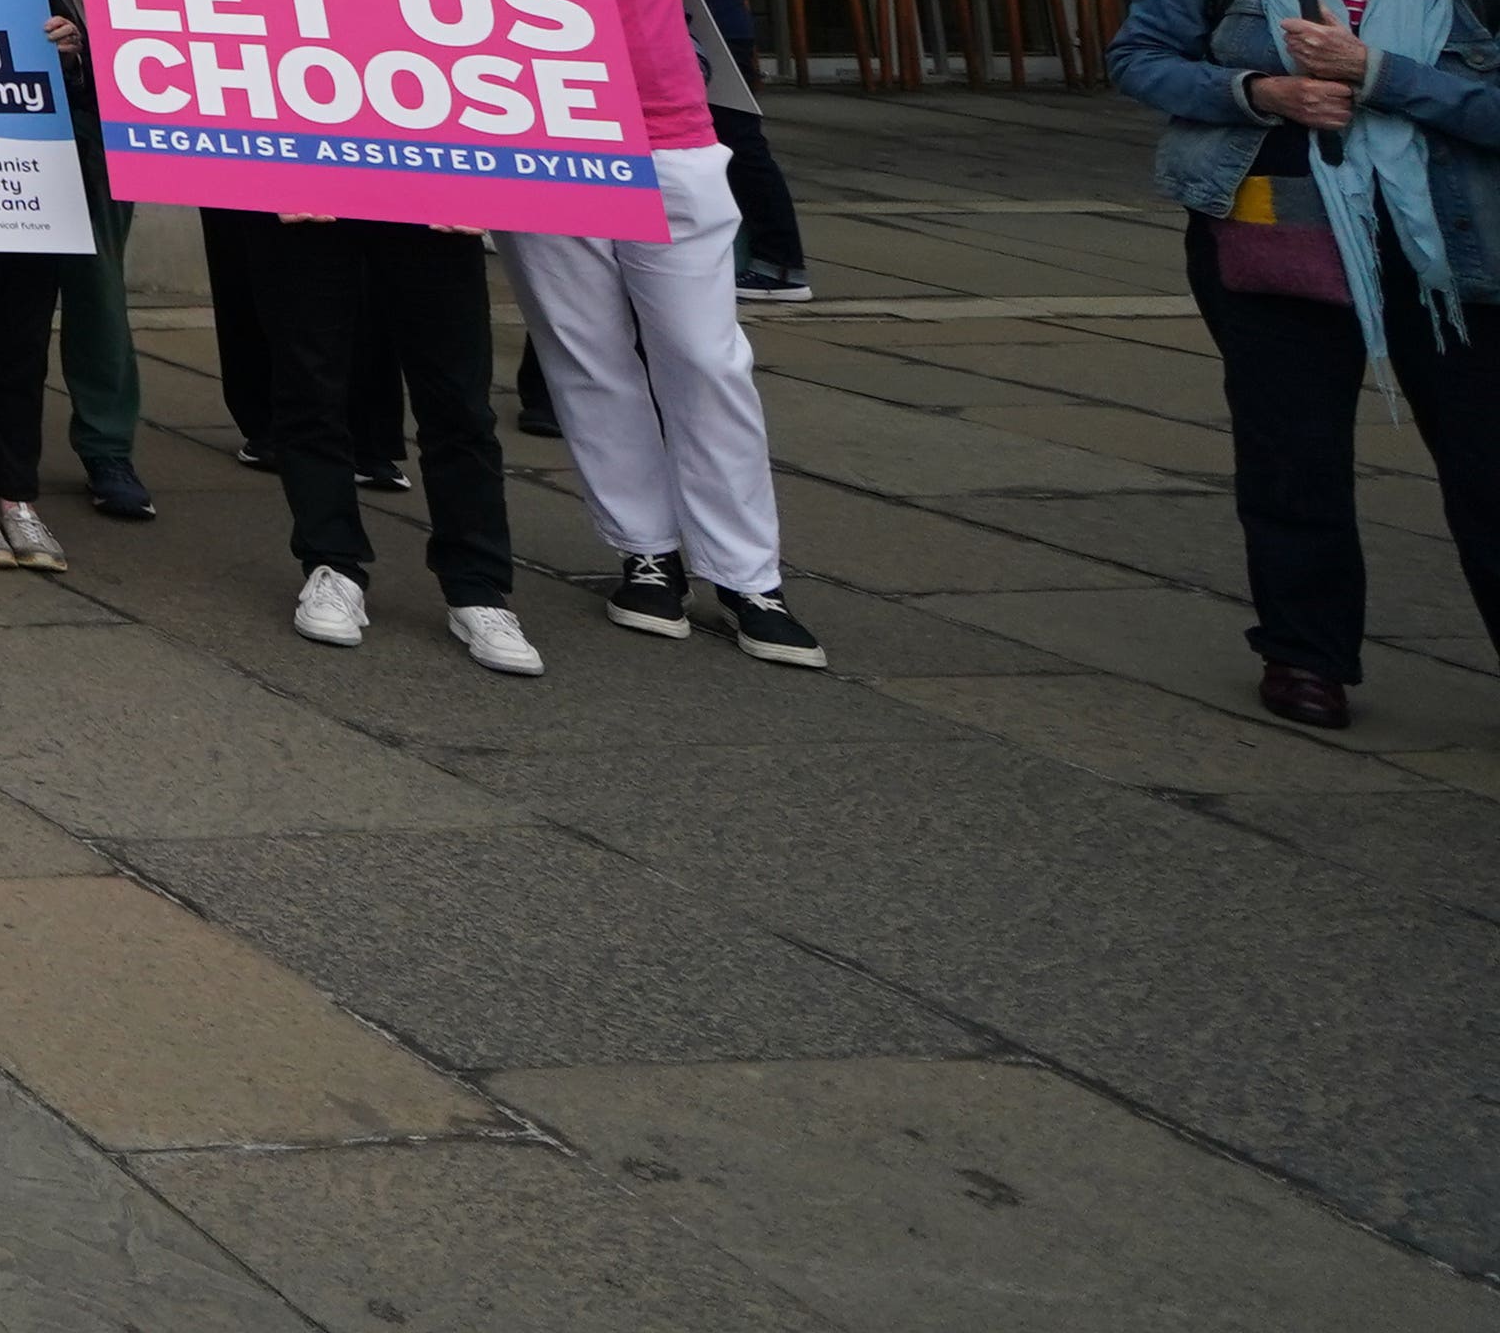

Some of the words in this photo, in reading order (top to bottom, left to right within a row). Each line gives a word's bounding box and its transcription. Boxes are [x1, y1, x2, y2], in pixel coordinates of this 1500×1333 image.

[112, 38, 625, 143] CHOOSE
[128, 127, 299, 160] LEGALISE
[316, 140, 497, 172] ASSISTED
[515, 152, 634, 182] DYING
